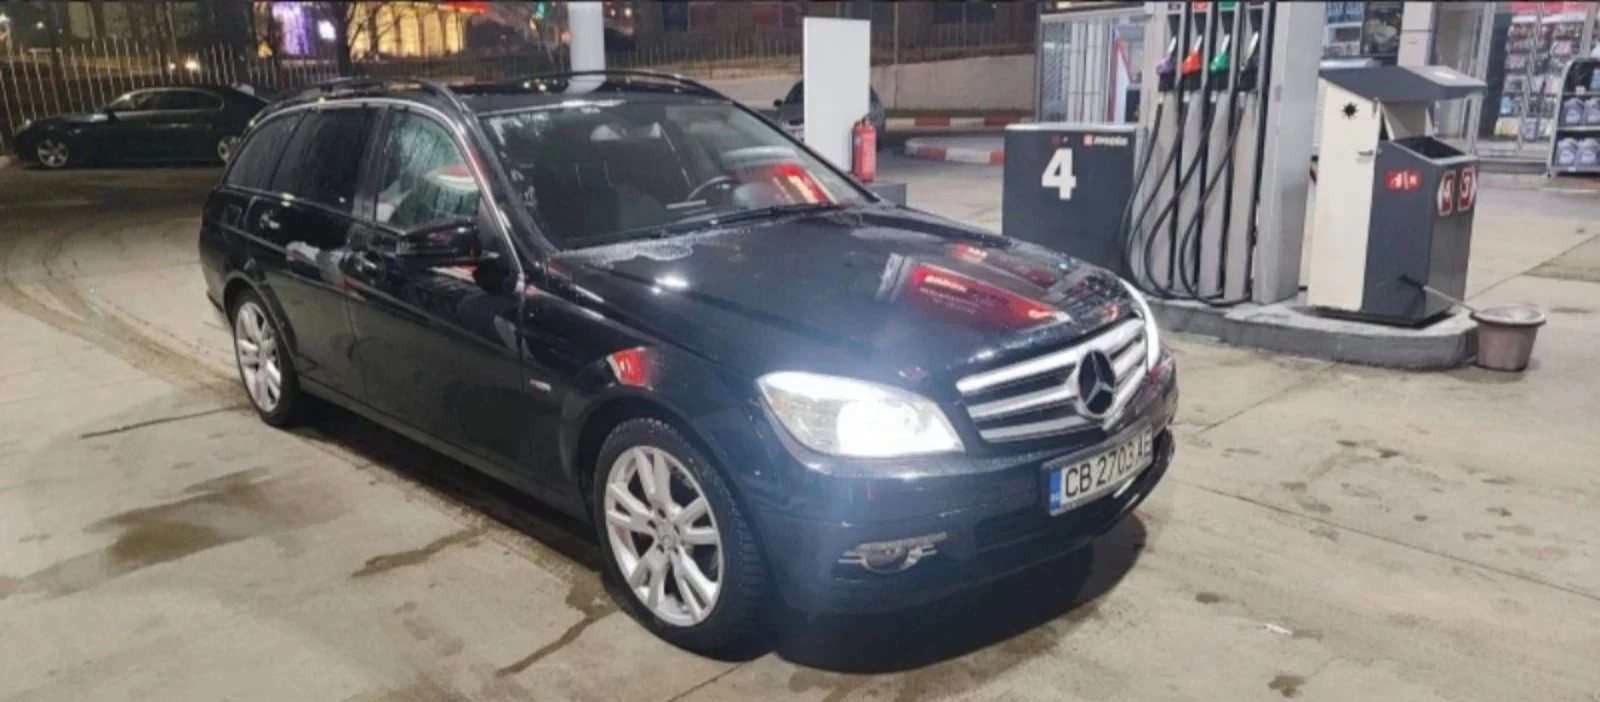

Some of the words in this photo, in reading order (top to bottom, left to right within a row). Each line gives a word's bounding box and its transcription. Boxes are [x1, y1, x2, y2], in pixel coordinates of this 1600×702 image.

[1041, 147, 1077, 200] 4
[1065, 463, 1093, 498] CB
[1096, 440, 1134, 486] 2703
